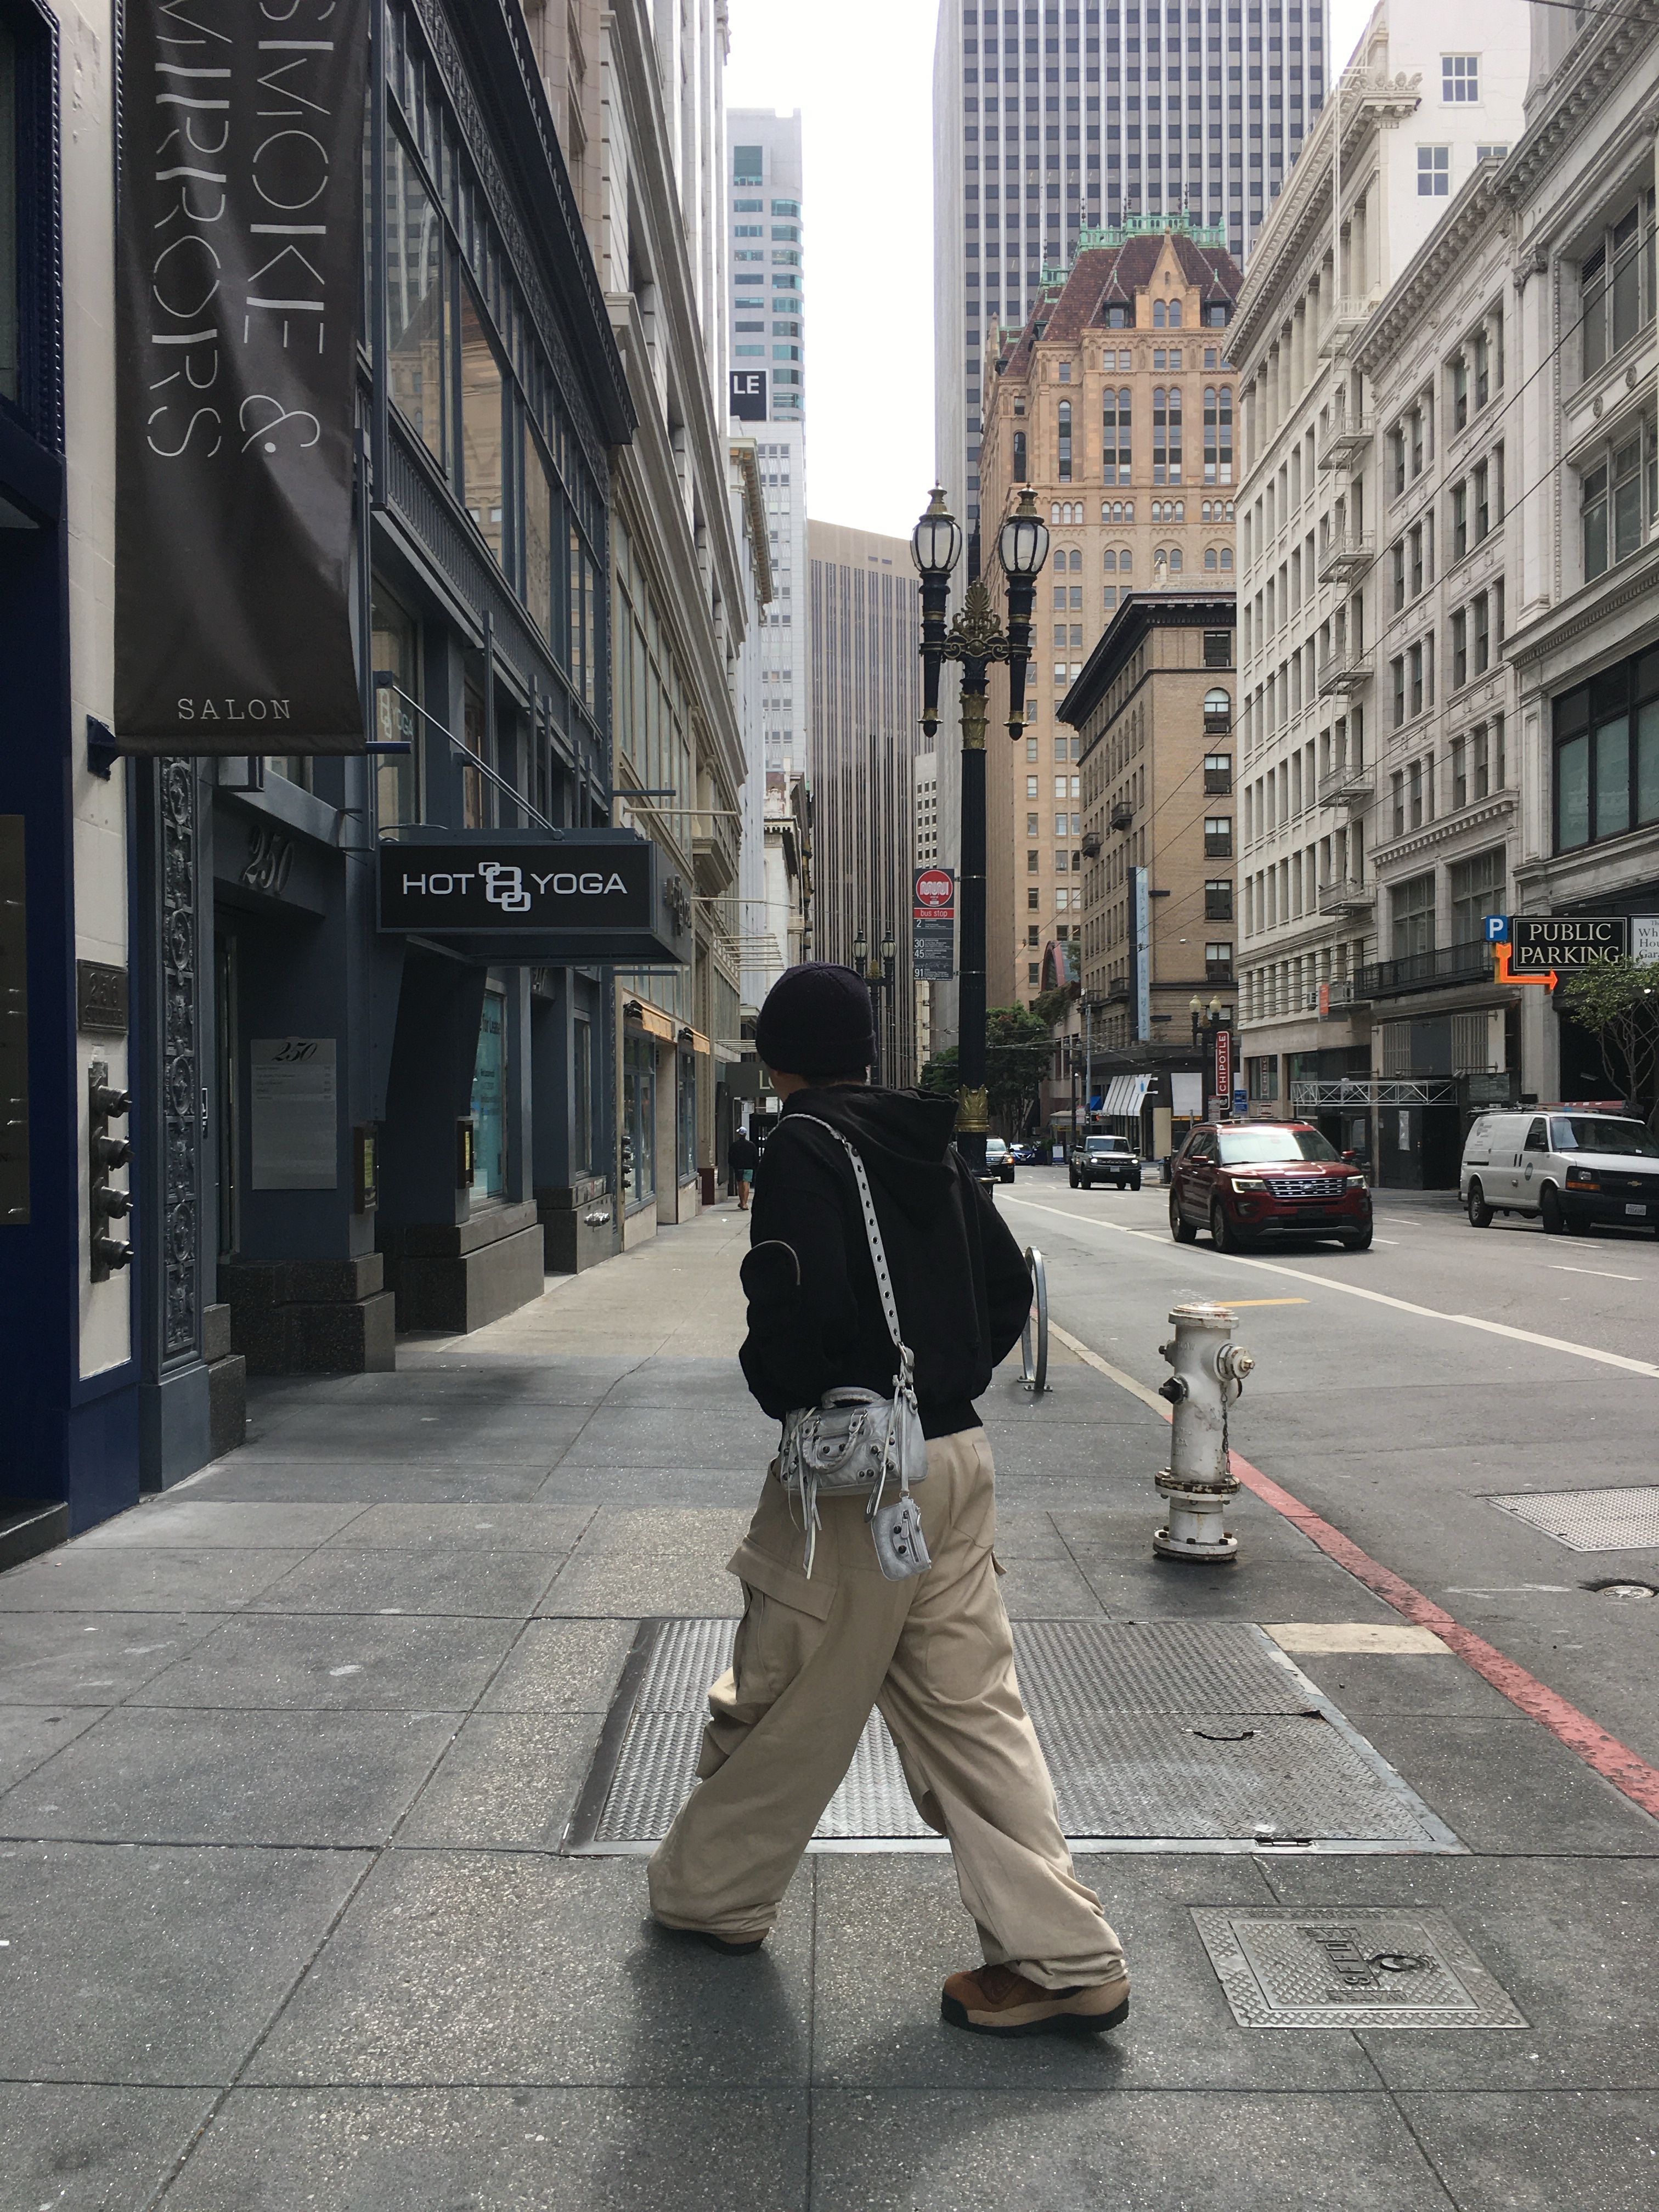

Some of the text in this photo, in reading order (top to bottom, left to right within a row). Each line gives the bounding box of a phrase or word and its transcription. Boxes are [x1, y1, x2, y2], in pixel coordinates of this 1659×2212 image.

[733, 375, 760, 394] LE
[240, 394, 320, 454] &
[178, 698, 291, 720] SALON
[244, 826, 295, 895] 250
[403, 873, 628, 895] HOT YOGA
[916, 919, 922, 928] 2
[933, 910, 947, 918] stop
[1489, 918, 1503, 938] P
[1529, 923, 1612, 941] PUBLIC
[915, 939, 924, 948] 30
[915, 950, 924, 958] 45
[1520, 946, 1620, 964] PARKING
[915, 968, 923, 977] 91
[272, 1042, 318, 1062] 250
[1218, 1035, 1227, 1092] CHIPOTLE
[1324, 1942, 1372, 1985] SFFD
